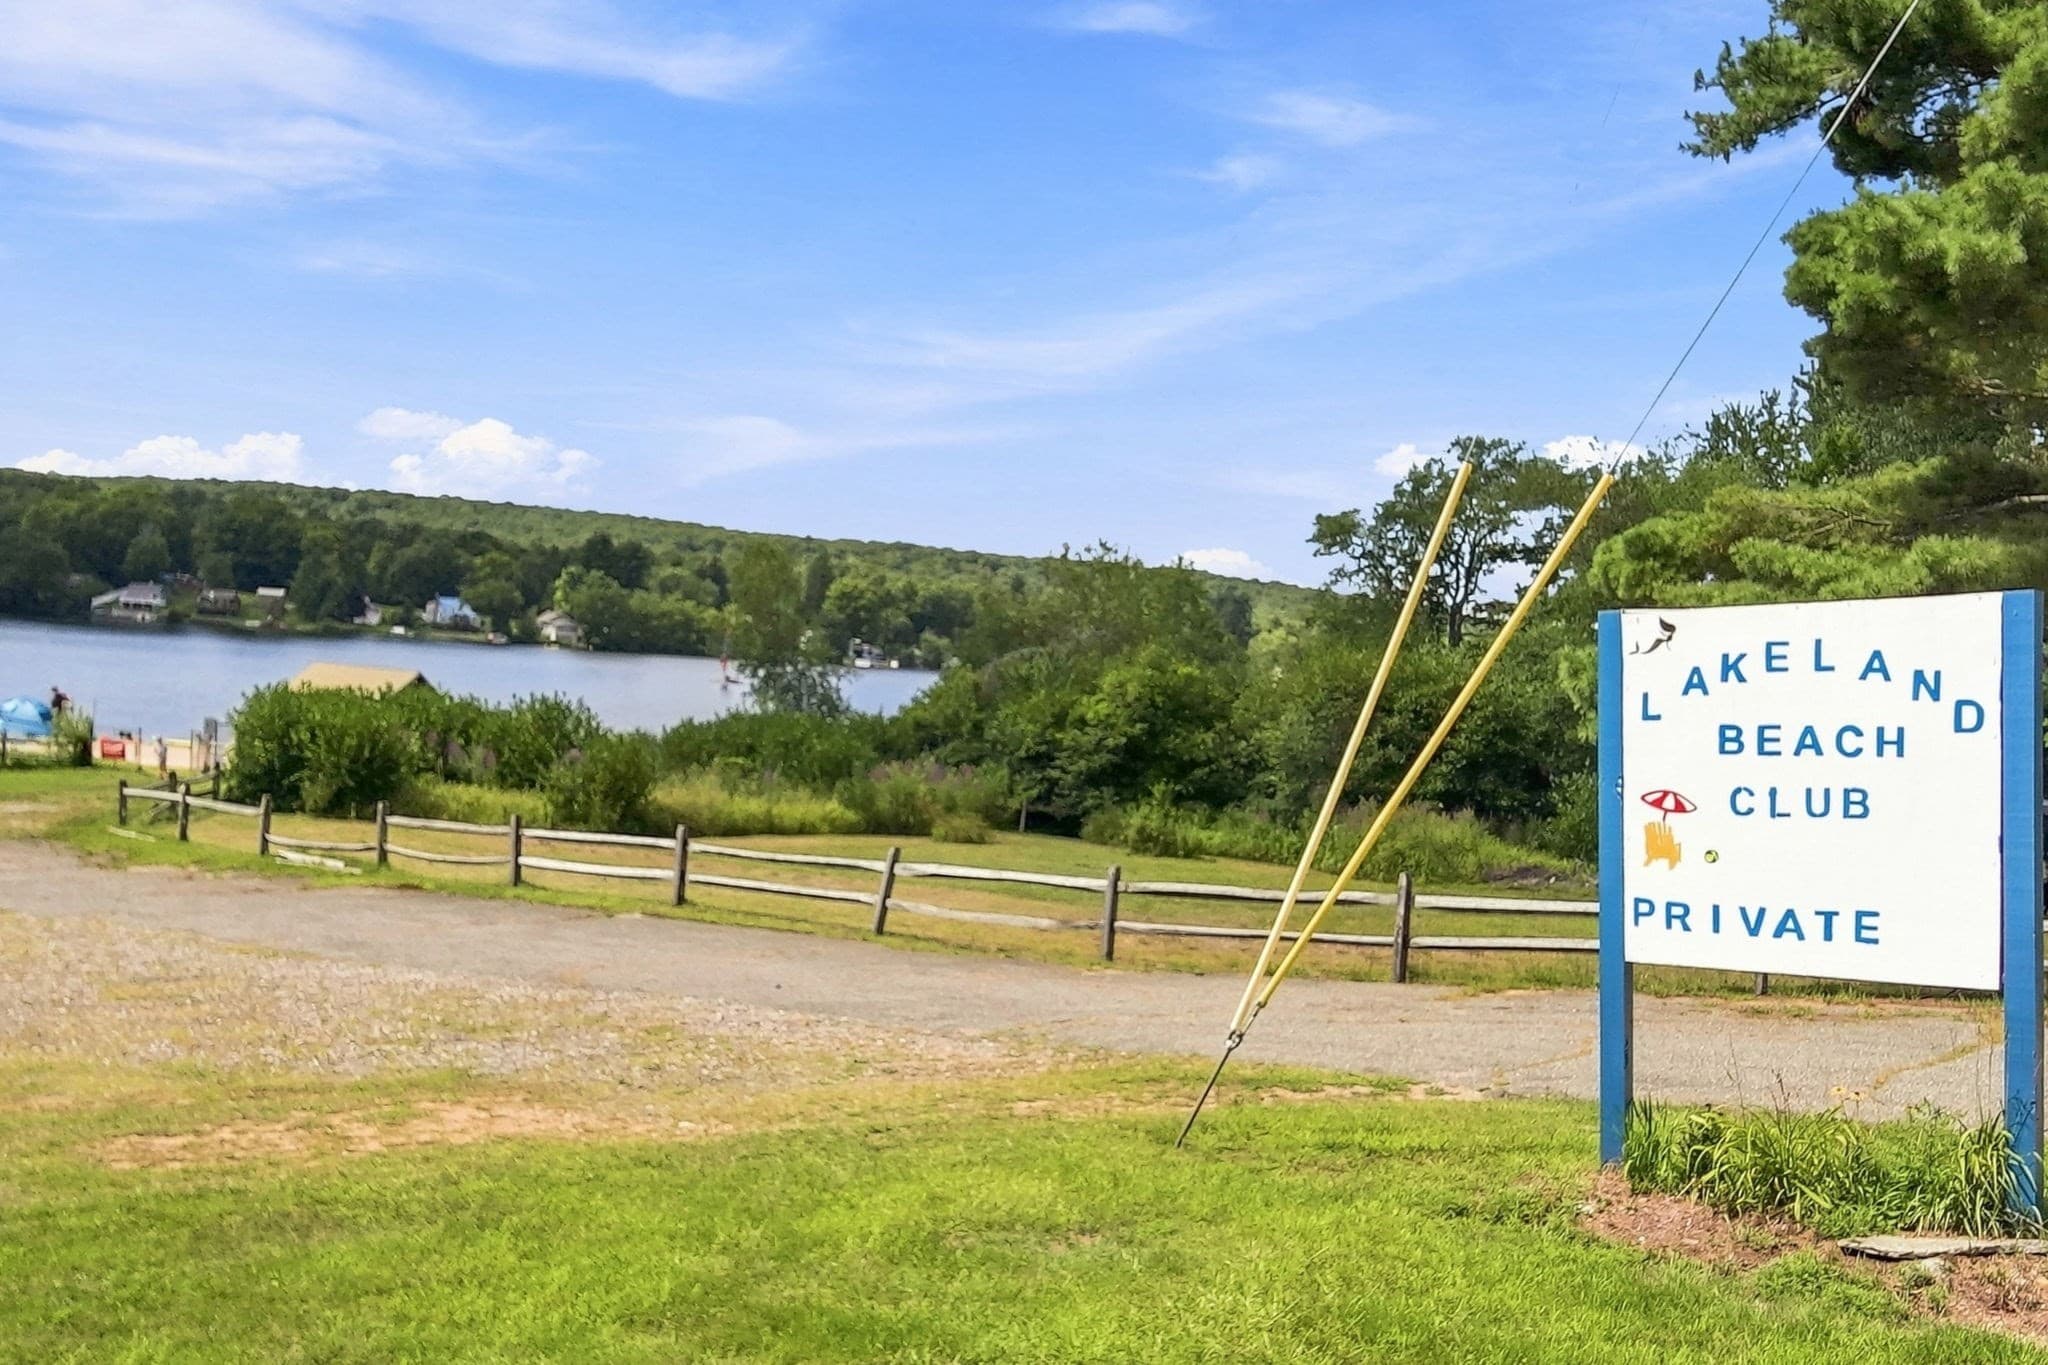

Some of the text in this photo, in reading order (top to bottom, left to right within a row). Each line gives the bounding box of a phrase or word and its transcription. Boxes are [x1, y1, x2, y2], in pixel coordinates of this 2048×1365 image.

[1641, 638, 1985, 733] LAKELAND
[1718, 724, 1905, 757] BEACH
[1730, 786, 1870, 819] CLUB
[1633, 897, 1880, 944] PRIVATE
